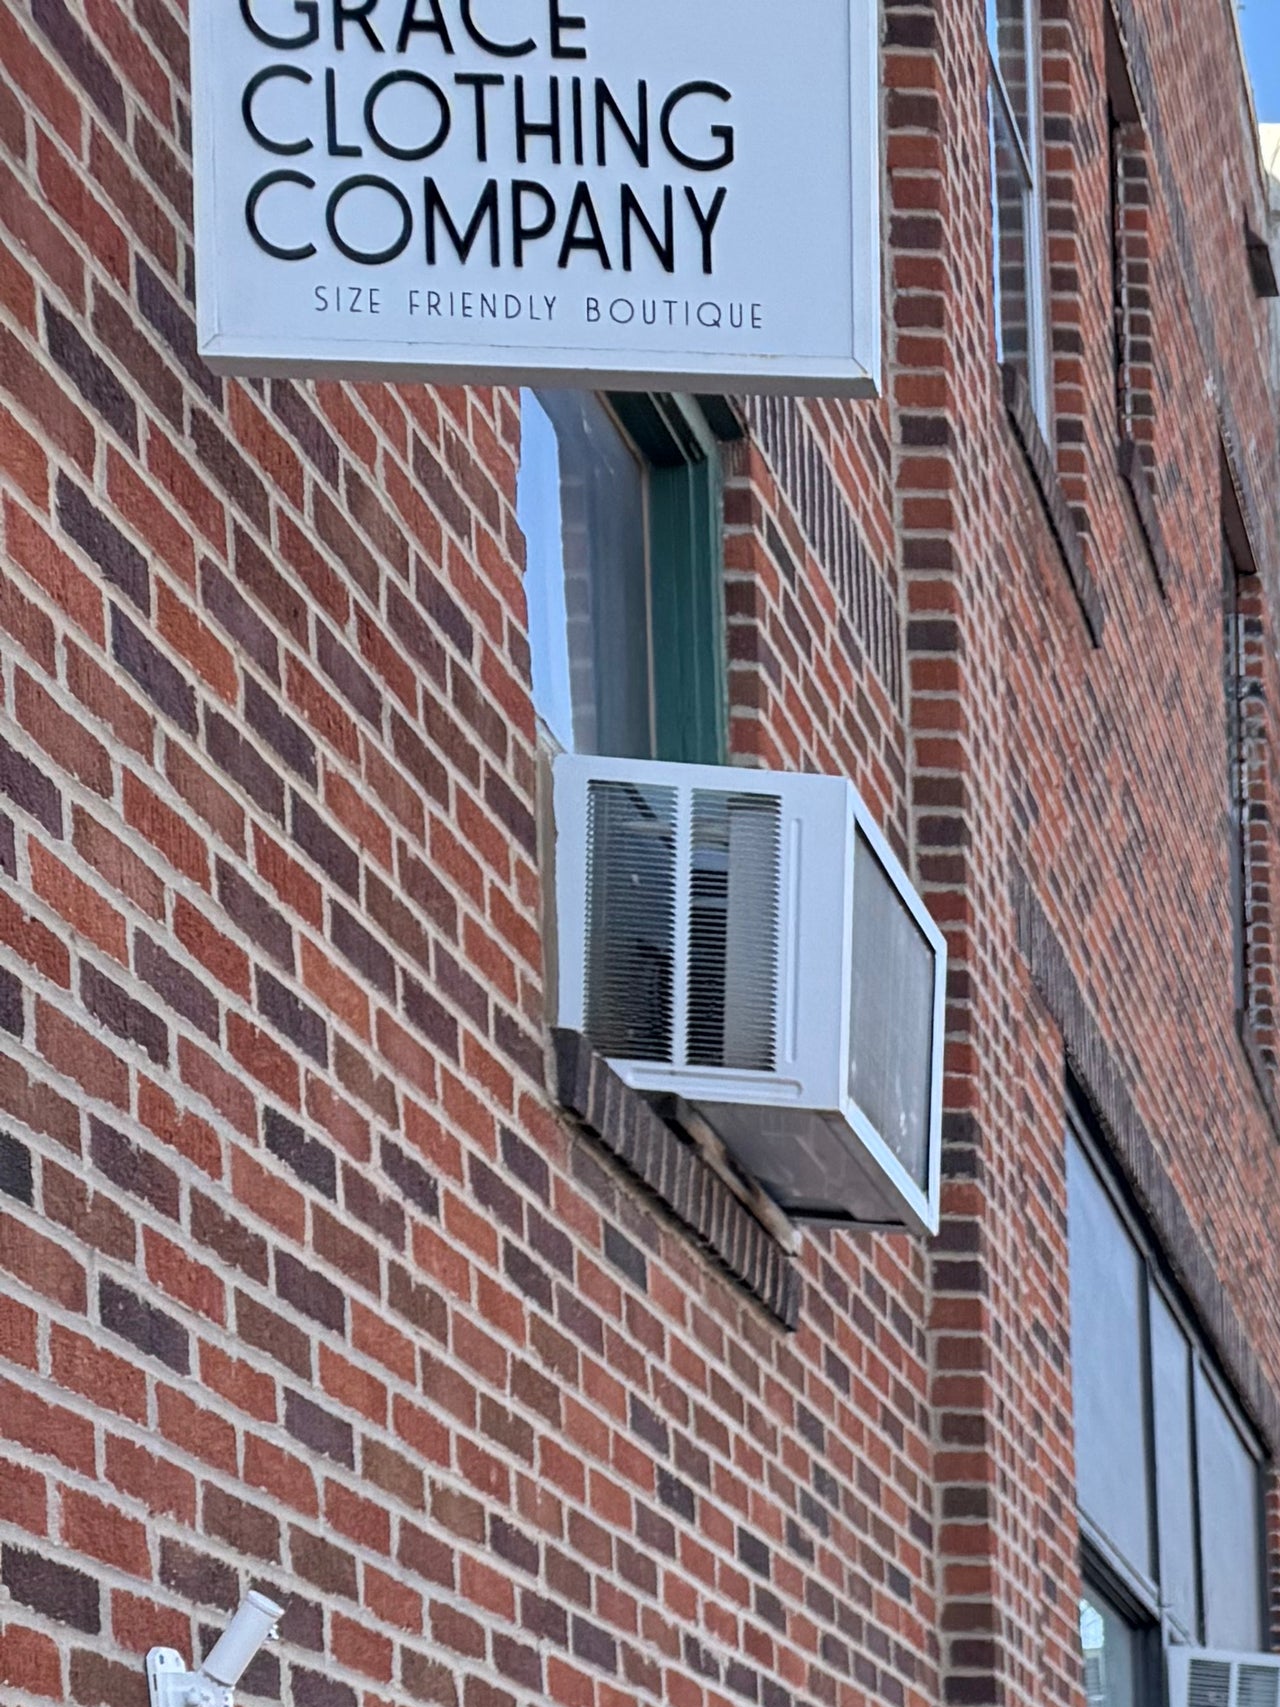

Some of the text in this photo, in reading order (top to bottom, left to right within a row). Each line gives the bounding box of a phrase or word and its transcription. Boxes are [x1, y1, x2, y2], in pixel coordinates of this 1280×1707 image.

[239, 0, 586, 59] GRACE
[242, 65, 733, 171] CLOTHING
[245, 170, 726, 274] COMPANY
[315, 286, 761, 328] SIZE FRIENDLY BOUTIQUE
